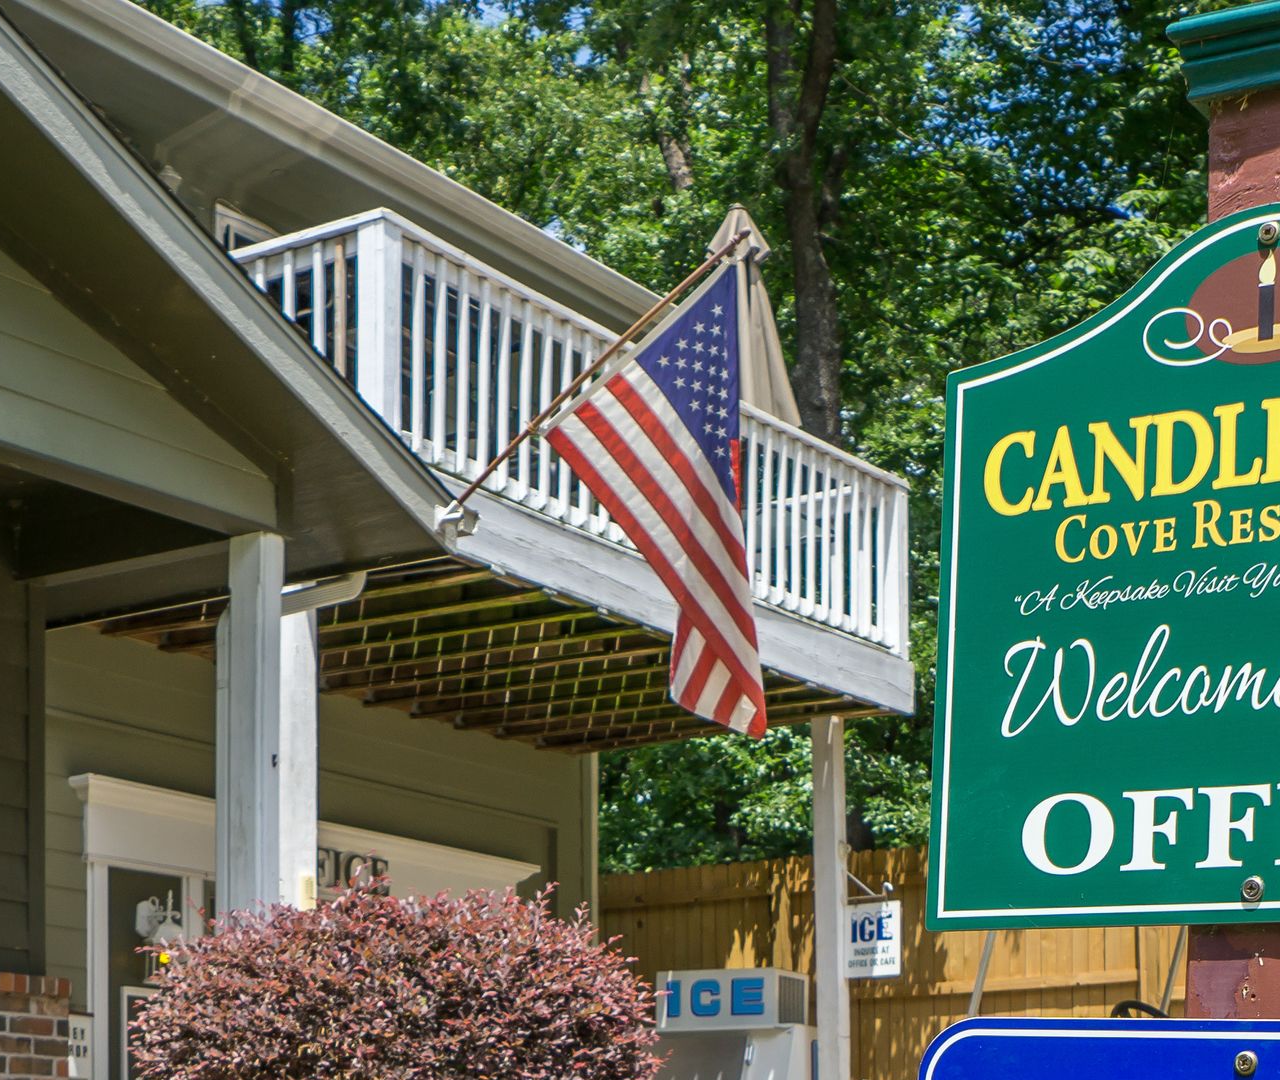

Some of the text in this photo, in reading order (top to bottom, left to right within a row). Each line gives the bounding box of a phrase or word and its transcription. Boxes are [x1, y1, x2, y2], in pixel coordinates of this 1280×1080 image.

[1060, 575, 1171, 610] Keepsake
[1172, 566, 1242, 598] Visit
[851, 911, 893, 943] ICE
[847, 959, 868, 969] OFFICE
[880, 957, 896, 966] CAFE
[881, 945, 890, 954] AT
[666, 976, 765, 1018] ICE
